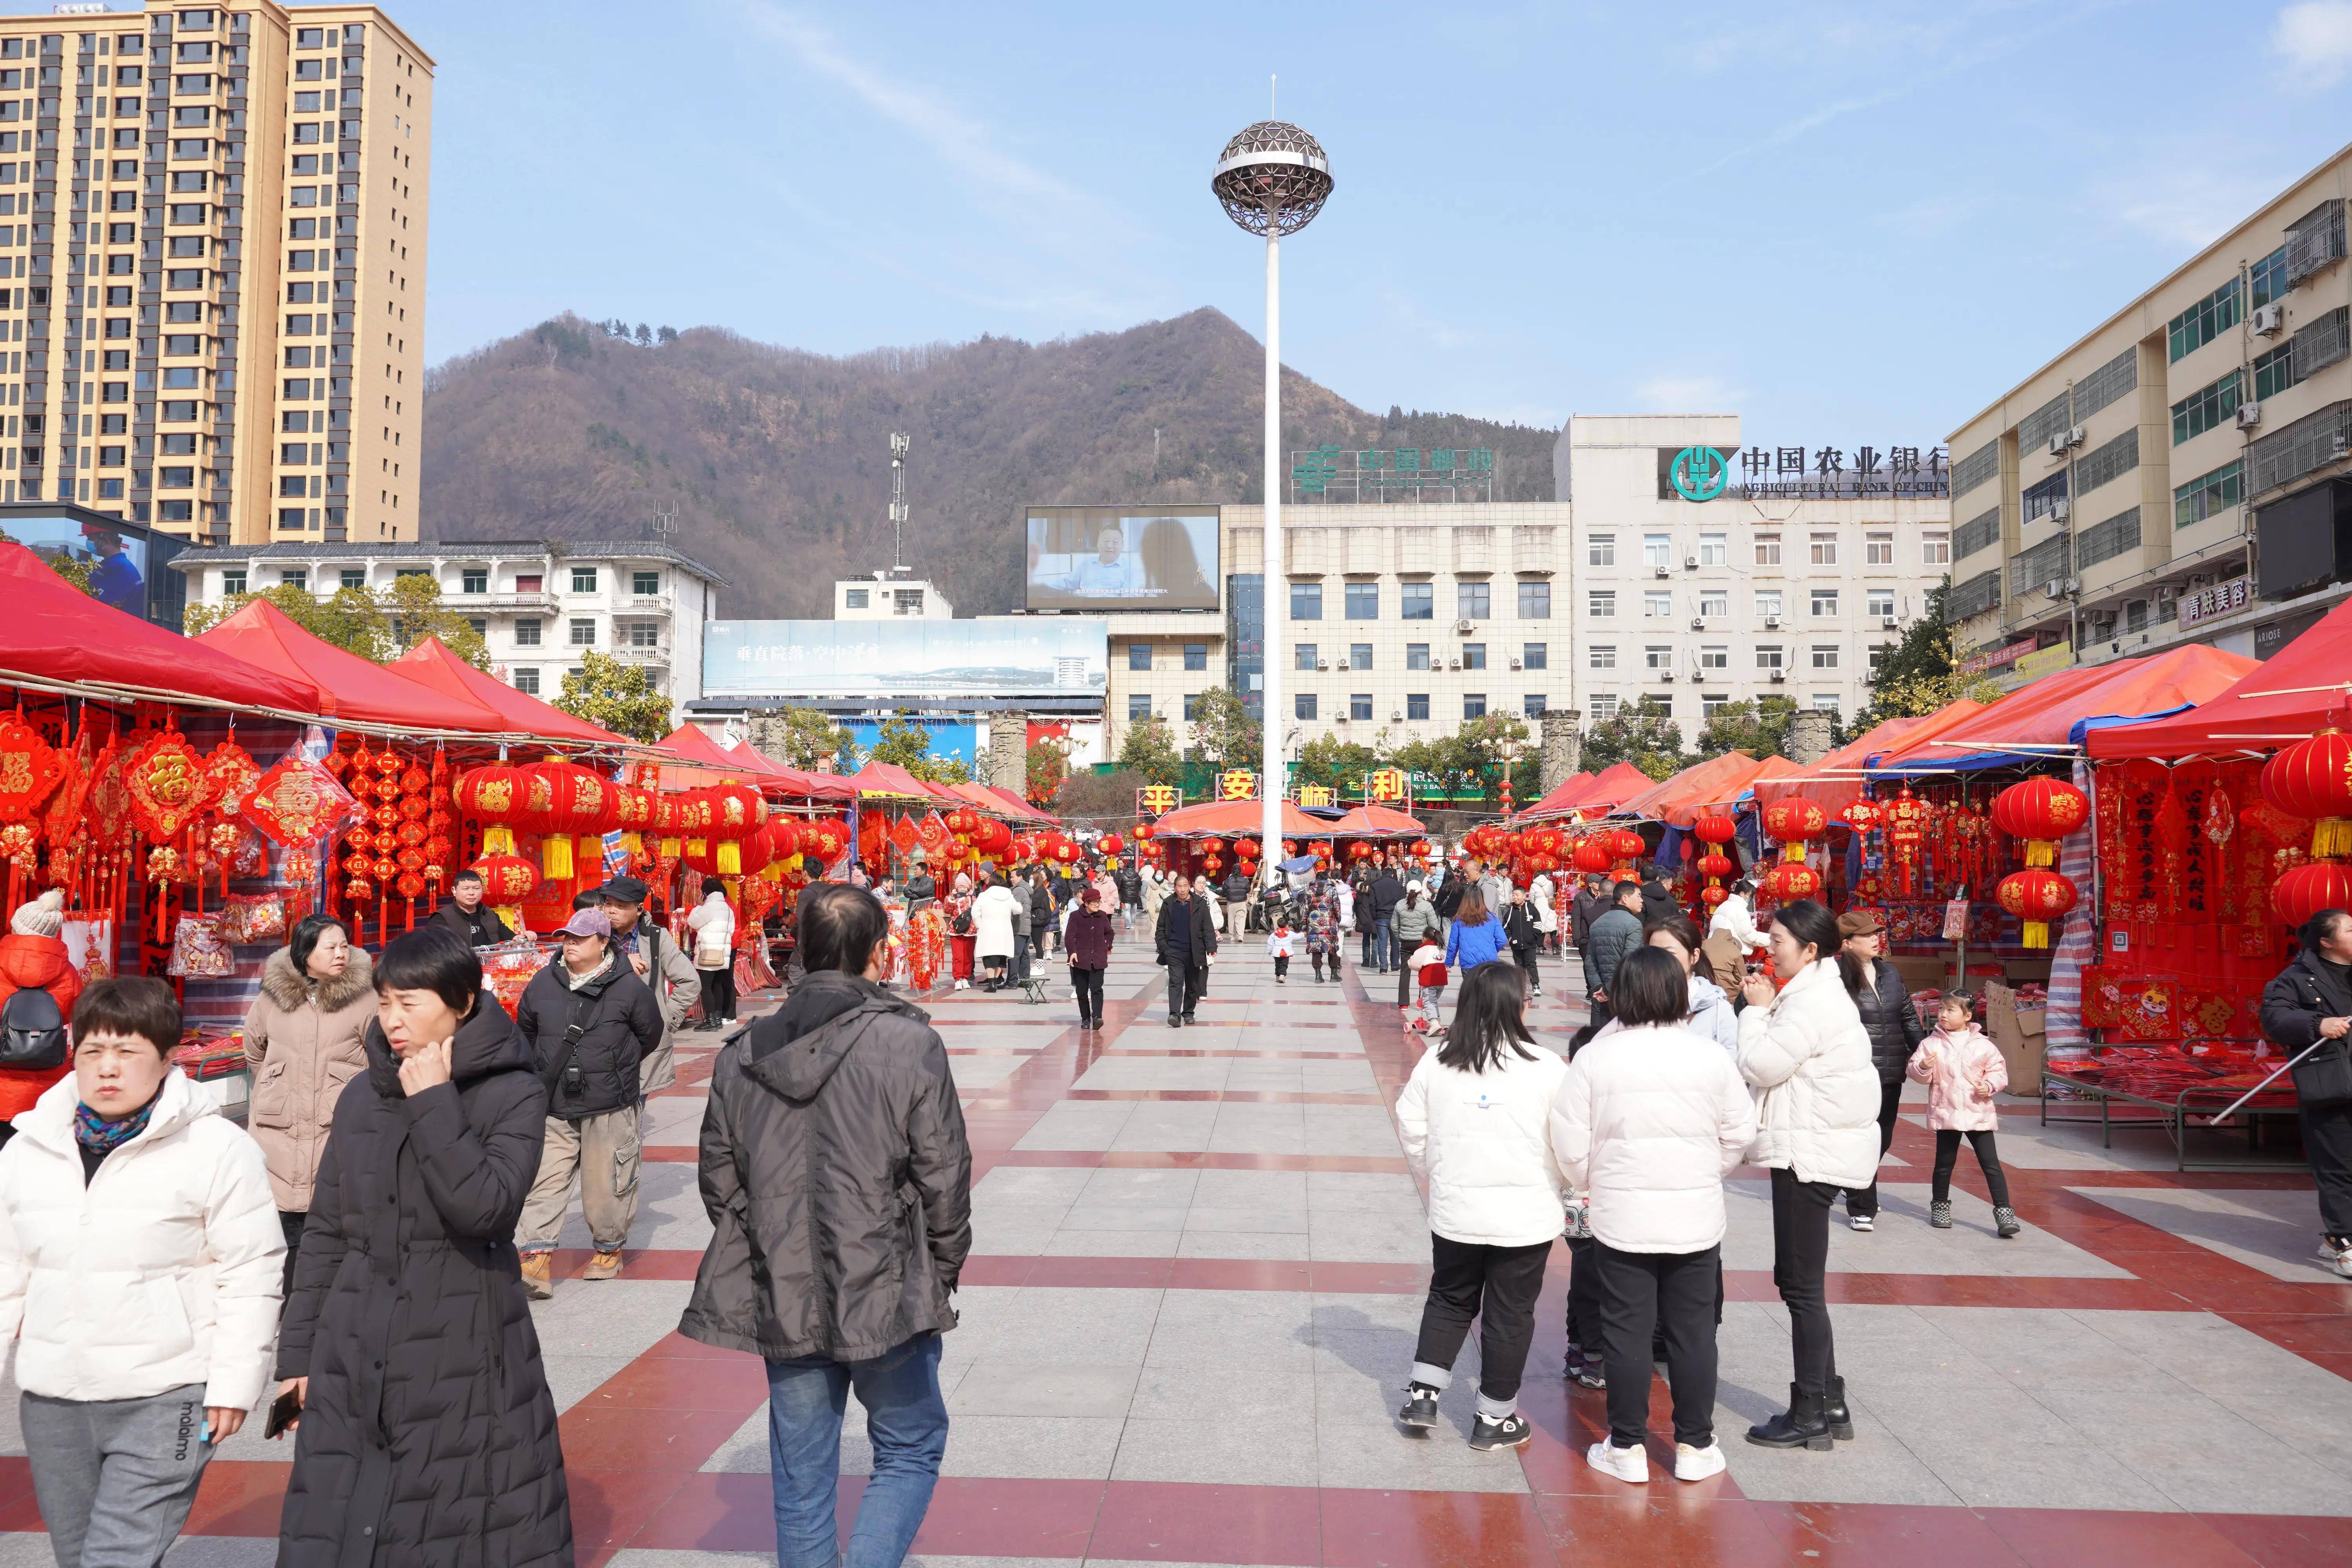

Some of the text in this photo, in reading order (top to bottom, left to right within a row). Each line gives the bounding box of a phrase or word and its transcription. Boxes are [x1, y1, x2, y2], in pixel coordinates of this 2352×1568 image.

[1359, 446, 1491, 472] 中国邮政
[1742, 446, 1948, 476] 中国农业银行
[1360, 475, 1491, 489] CHINA POST
[1744, 482, 1949, 492] AGRICULTURAL BANK OF CHIN
[2258, 628, 2281, 643] ARIOSE
[148, 755, 192, 801] 福
[1143, 769, 1403, 815] 平 安 顺 利
[273, 771, 319, 814] 福
[1897, 802, 1913, 817] 福
[1523, 836, 1555, 851] 佳节
[2197, 996, 2235, 1034] 福
[175, 1401, 195, 1461] malaimo
